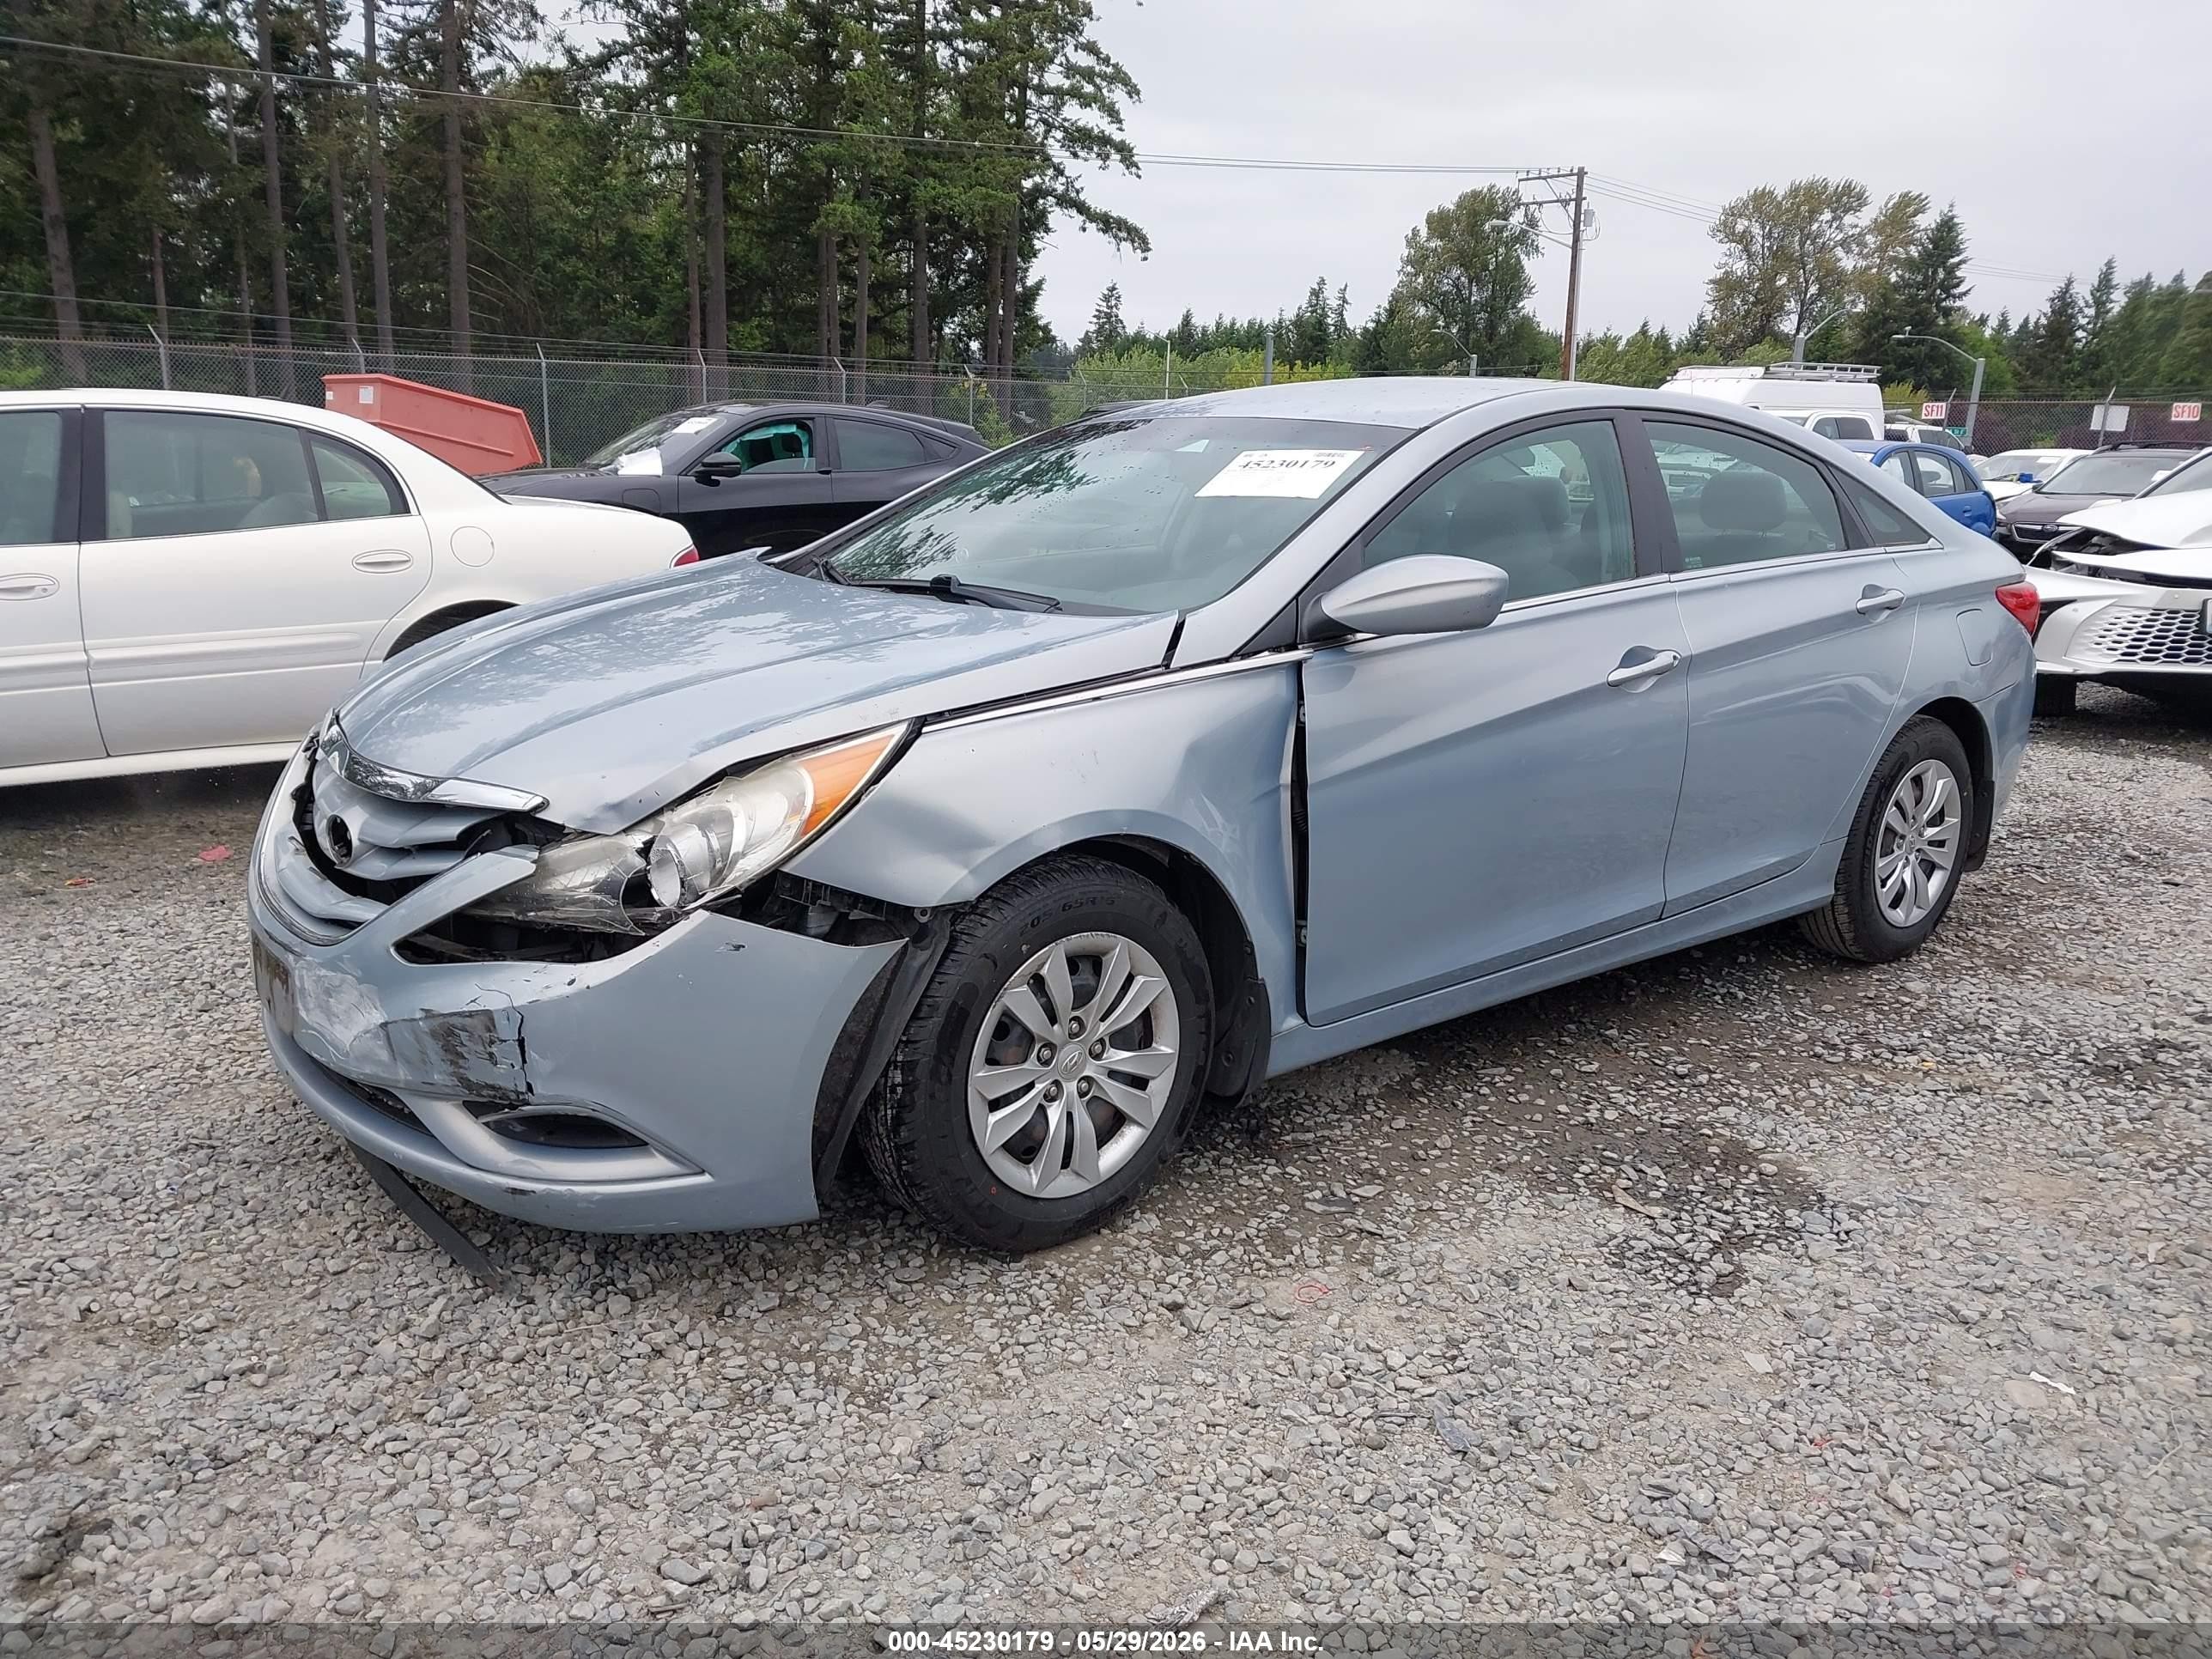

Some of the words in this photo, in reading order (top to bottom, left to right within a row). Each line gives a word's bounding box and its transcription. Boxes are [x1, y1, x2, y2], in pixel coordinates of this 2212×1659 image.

[1923, 404, 1944, 417] SF11
[2173, 404, 2200, 418] SF10
[1238, 459, 1336, 469] 45230179
